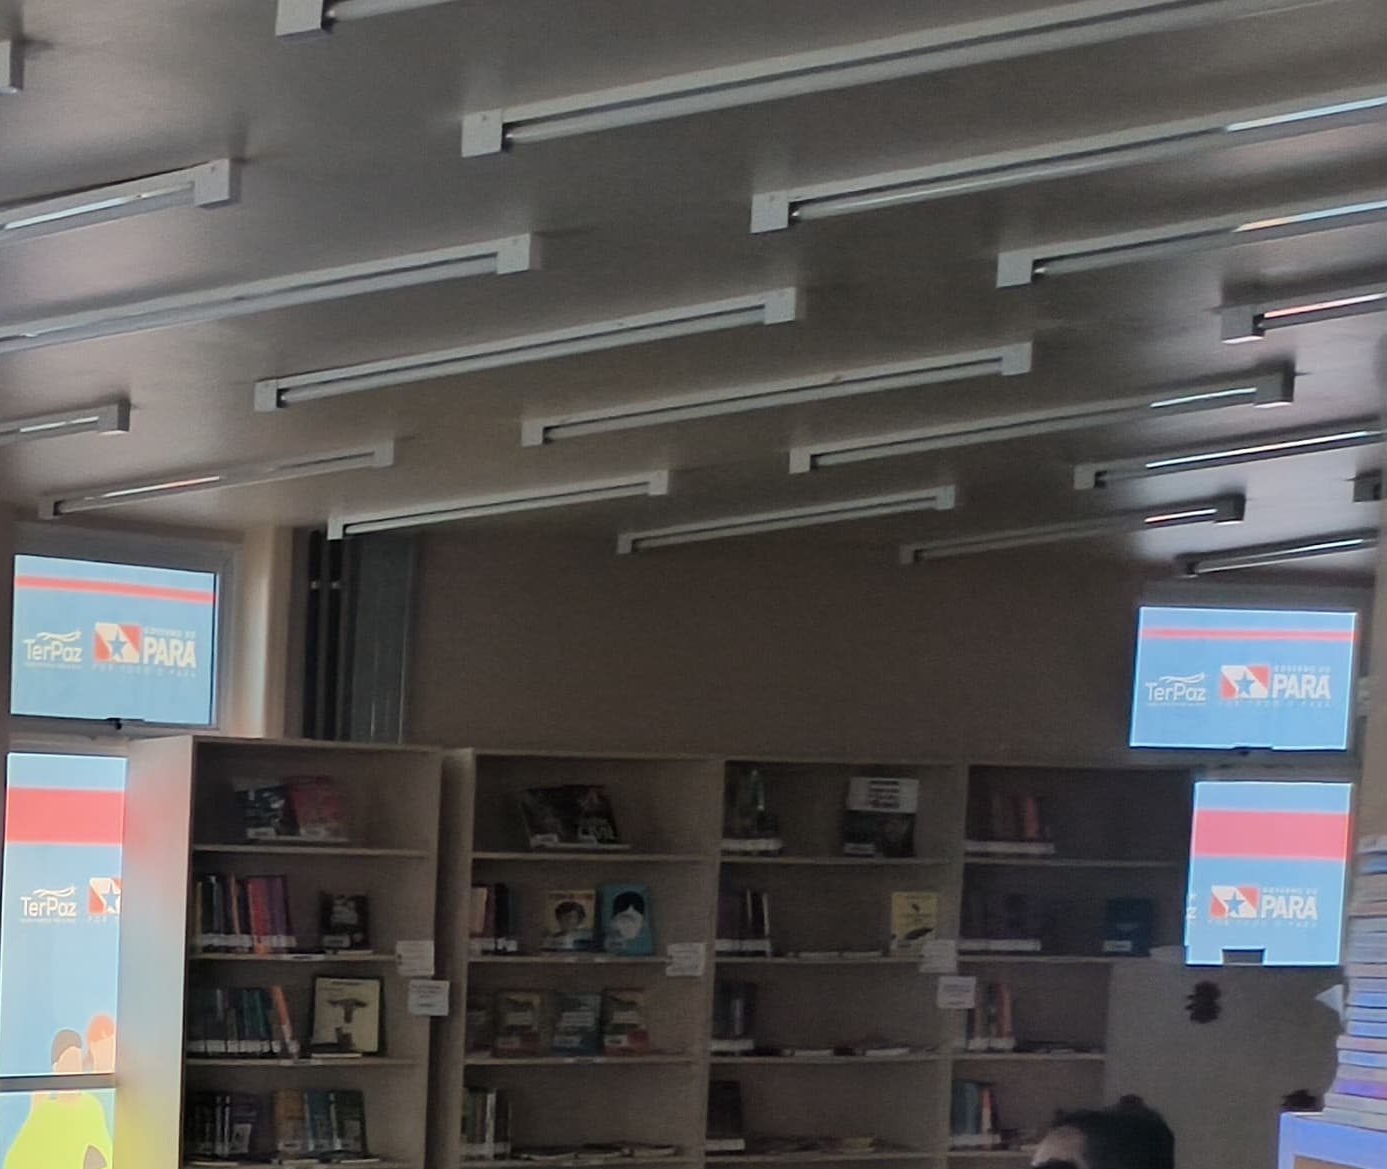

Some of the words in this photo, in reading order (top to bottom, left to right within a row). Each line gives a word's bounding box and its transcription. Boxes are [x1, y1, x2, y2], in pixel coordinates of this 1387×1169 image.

[22, 639, 83, 664] TerPaz
[1145, 681, 1208, 702] TerPaz
[20, 896, 77, 917] TerPaz
